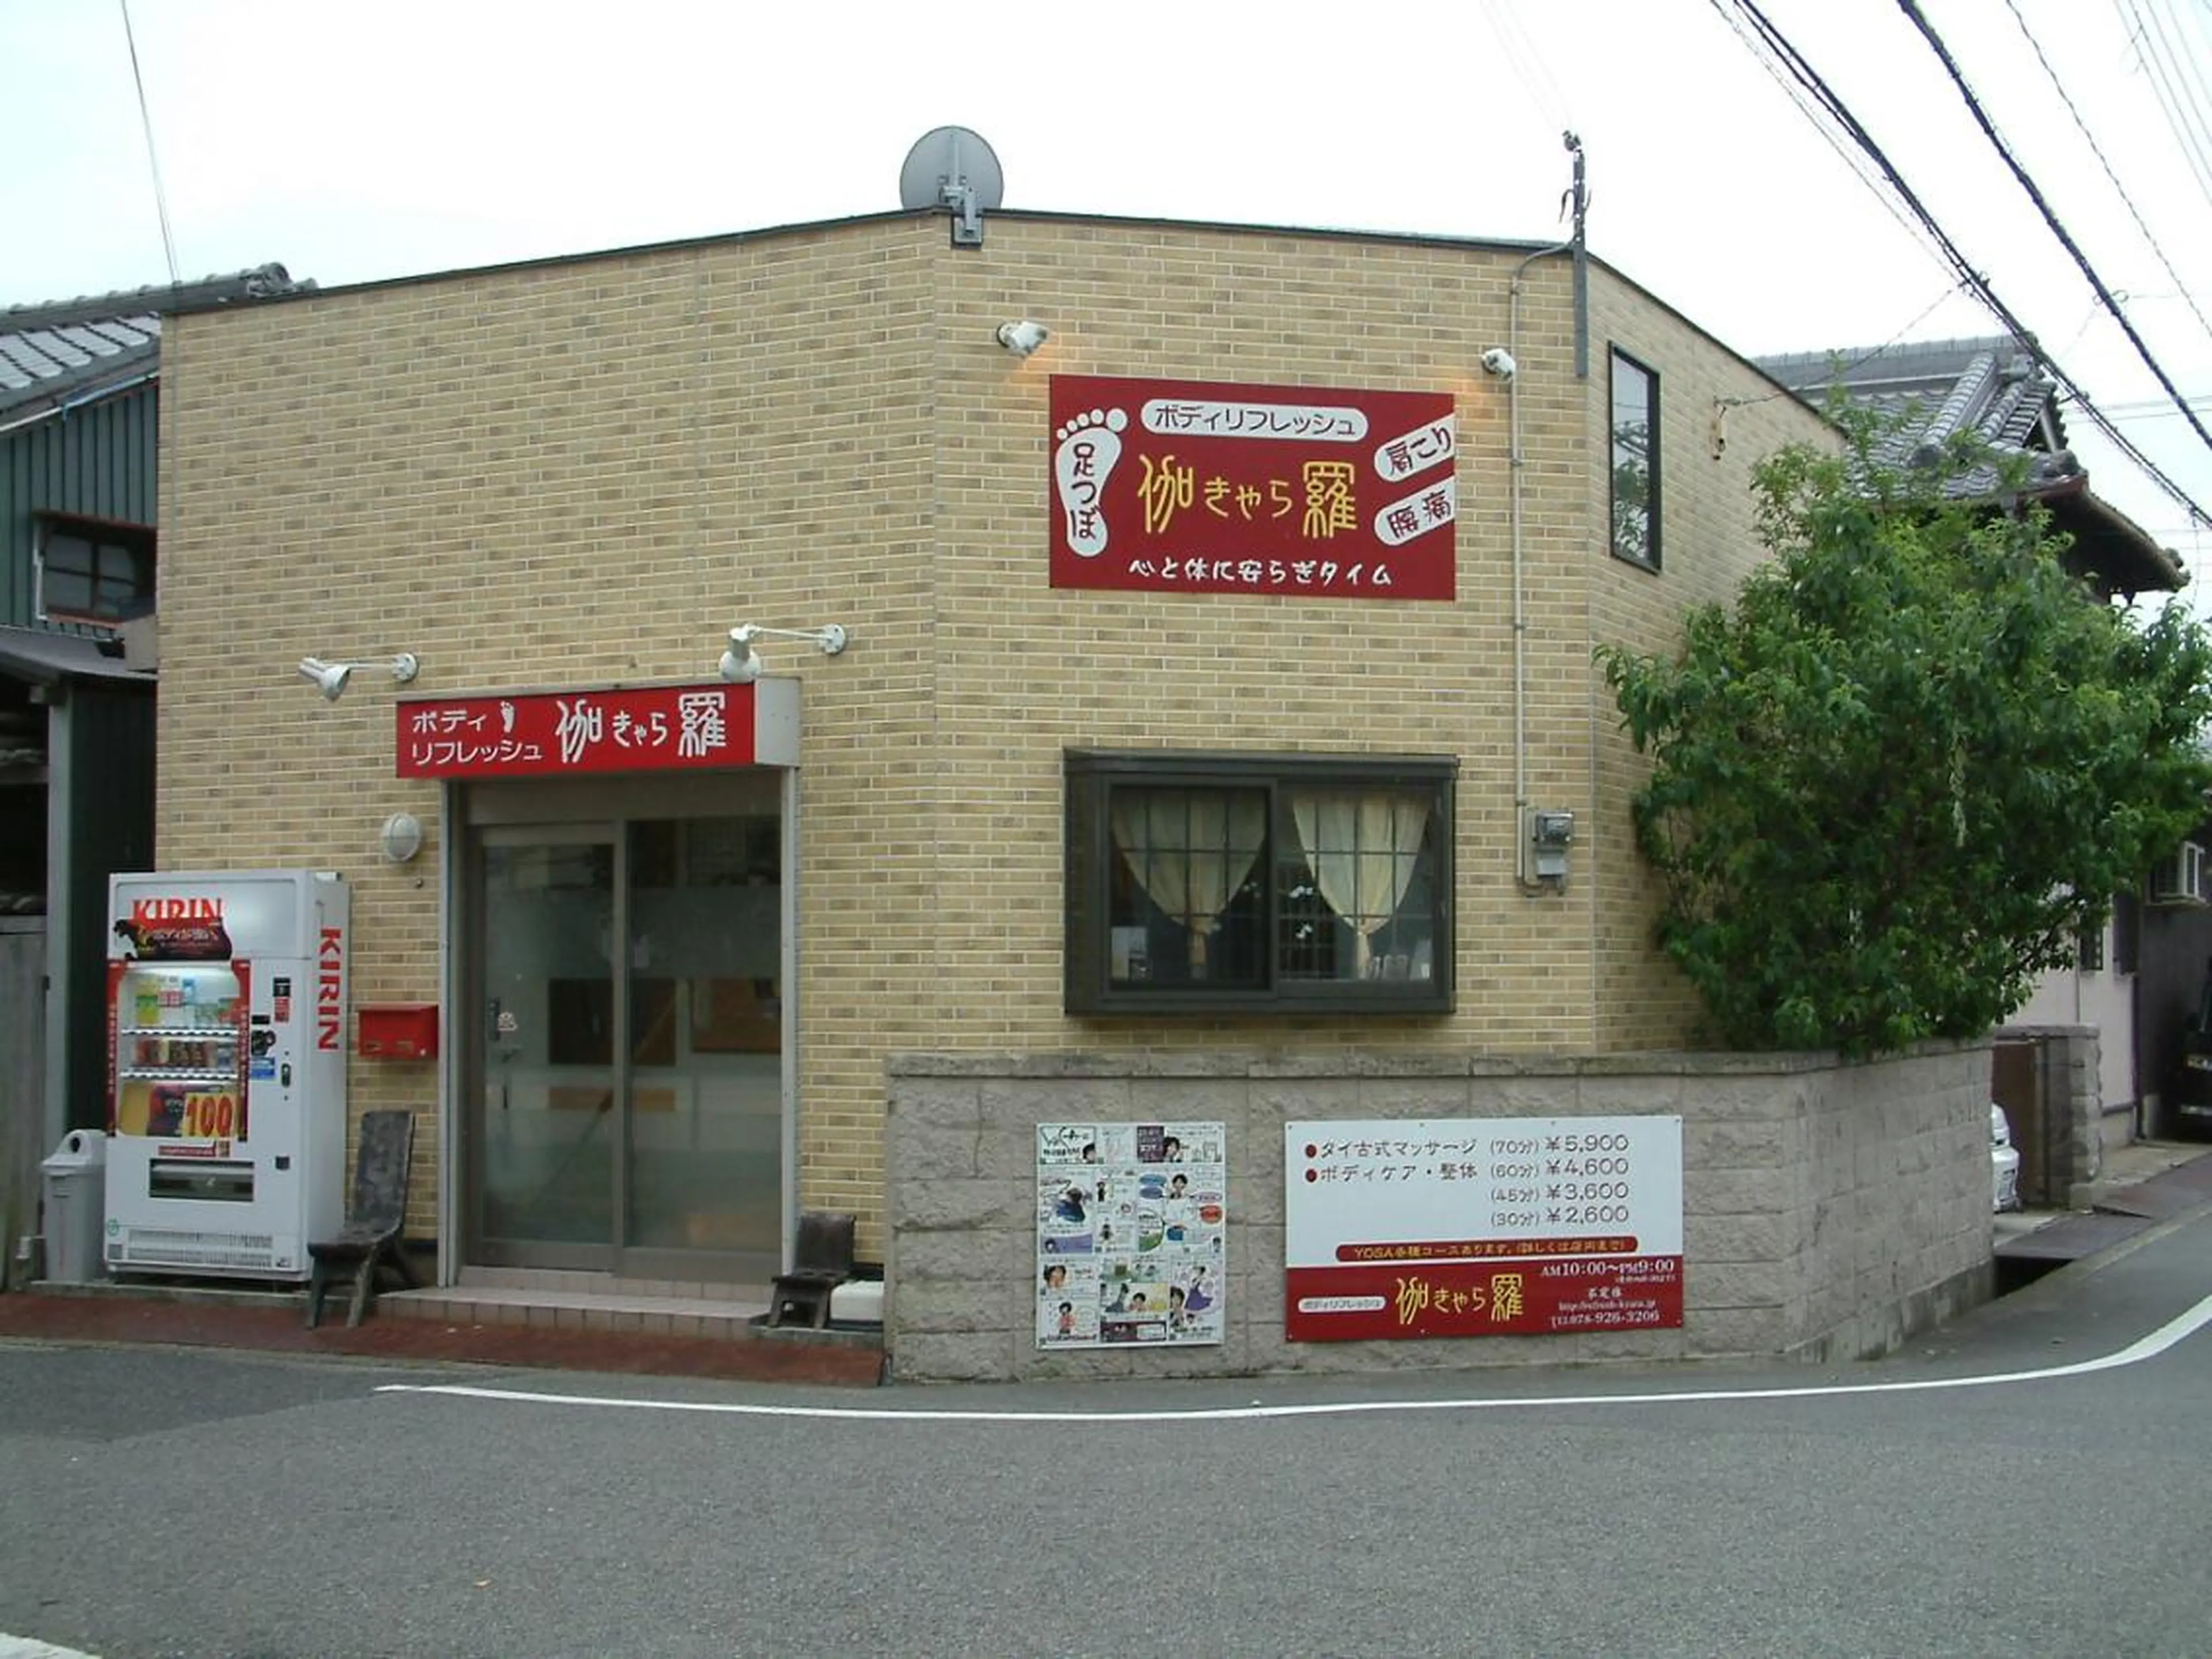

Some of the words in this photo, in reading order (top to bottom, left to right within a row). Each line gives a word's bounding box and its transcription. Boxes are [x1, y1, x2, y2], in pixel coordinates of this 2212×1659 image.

[1154, 406, 1356, 436] ボディリフレッシュ
[1385, 427, 1451, 476] 肩こり
[1070, 442, 1099, 540] 足つぼ
[1387, 489, 1451, 539] 腰痛
[1128, 556, 1393, 586] 心と体に安らぎタイム
[412, 709, 487, 733] ボディ
[411, 739, 543, 765] リフレッシュ
[131, 897, 223, 922] KIRIN
[318, 928, 342, 1051] KIRIN
[186, 1096, 233, 1138] 100
[1321, 1138, 1478, 1158] タイ古式マッサージ
[1490, 1140, 1540, 1154] (70分)
[1320, 1162, 1478, 1181] ボディケア・整体
[1491, 1188, 1540, 1202] (45分)
[1490, 1212, 1541, 1227] (30分)
